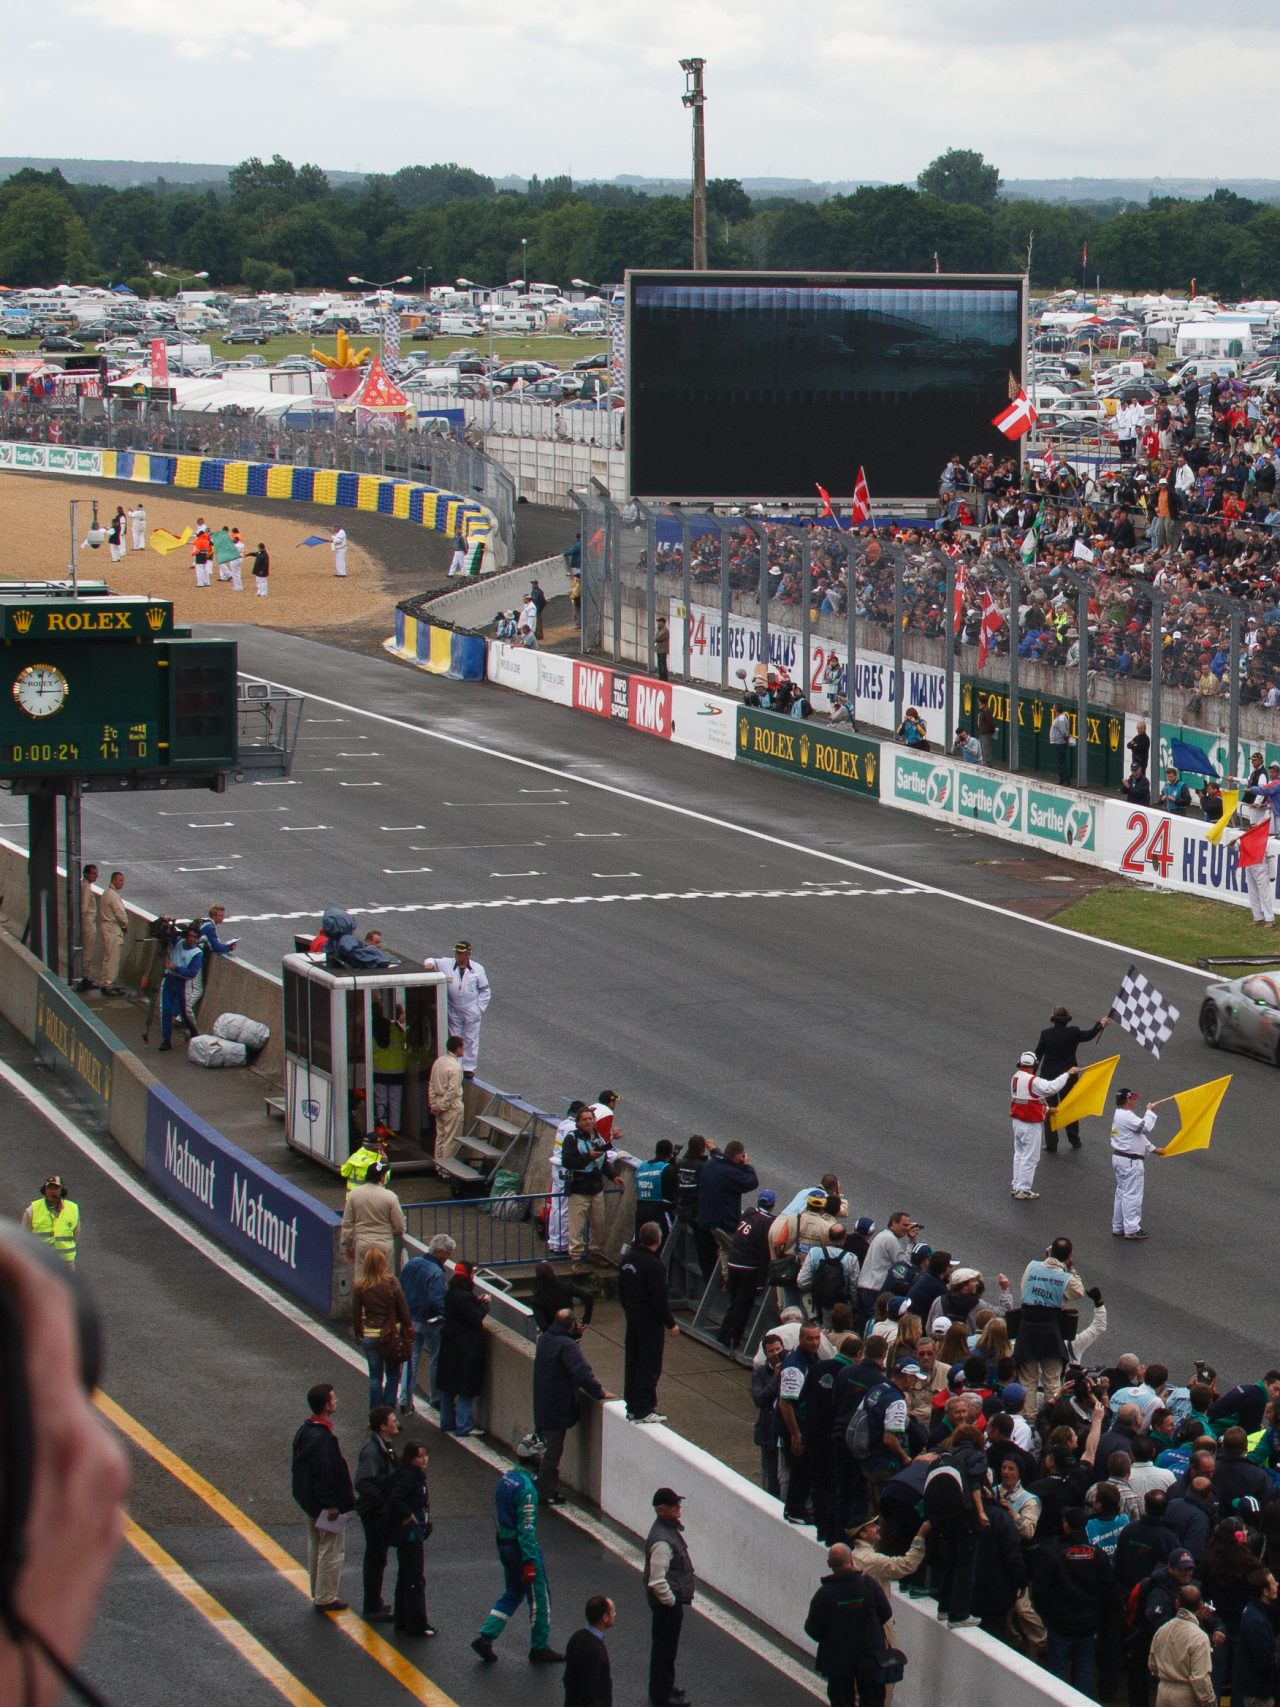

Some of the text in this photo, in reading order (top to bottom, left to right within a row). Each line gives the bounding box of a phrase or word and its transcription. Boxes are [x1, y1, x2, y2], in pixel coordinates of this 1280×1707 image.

[48, 612, 132, 631] ROLEX
[709, 624, 745, 659] HERES
[578, 666, 605, 712] RMC
[613, 690, 627, 706] TALK
[614, 677, 627, 693] INFO
[842, 662, 884, 700] HURES
[911, 671, 945, 710] MANS
[611, 703, 629, 719] SPORT
[636, 684, 665, 733] RMC
[13, 744, 79, 762] 0:00:24
[100, 743, 119, 759] 14
[753, 726, 794, 761] ROLEX
[814, 743, 859, 781] ROLEX
[896, 766, 926, 795] Sarthe
[960, 784, 993, 813] Sarthe
[1030, 802, 1064, 833] Sarthe
[1120, 810, 1174, 878] 24
[164, 1120, 216, 1210] Matmut
[230, 1172, 298, 1270] Matmut
[738, 1220, 752, 1235] 76
